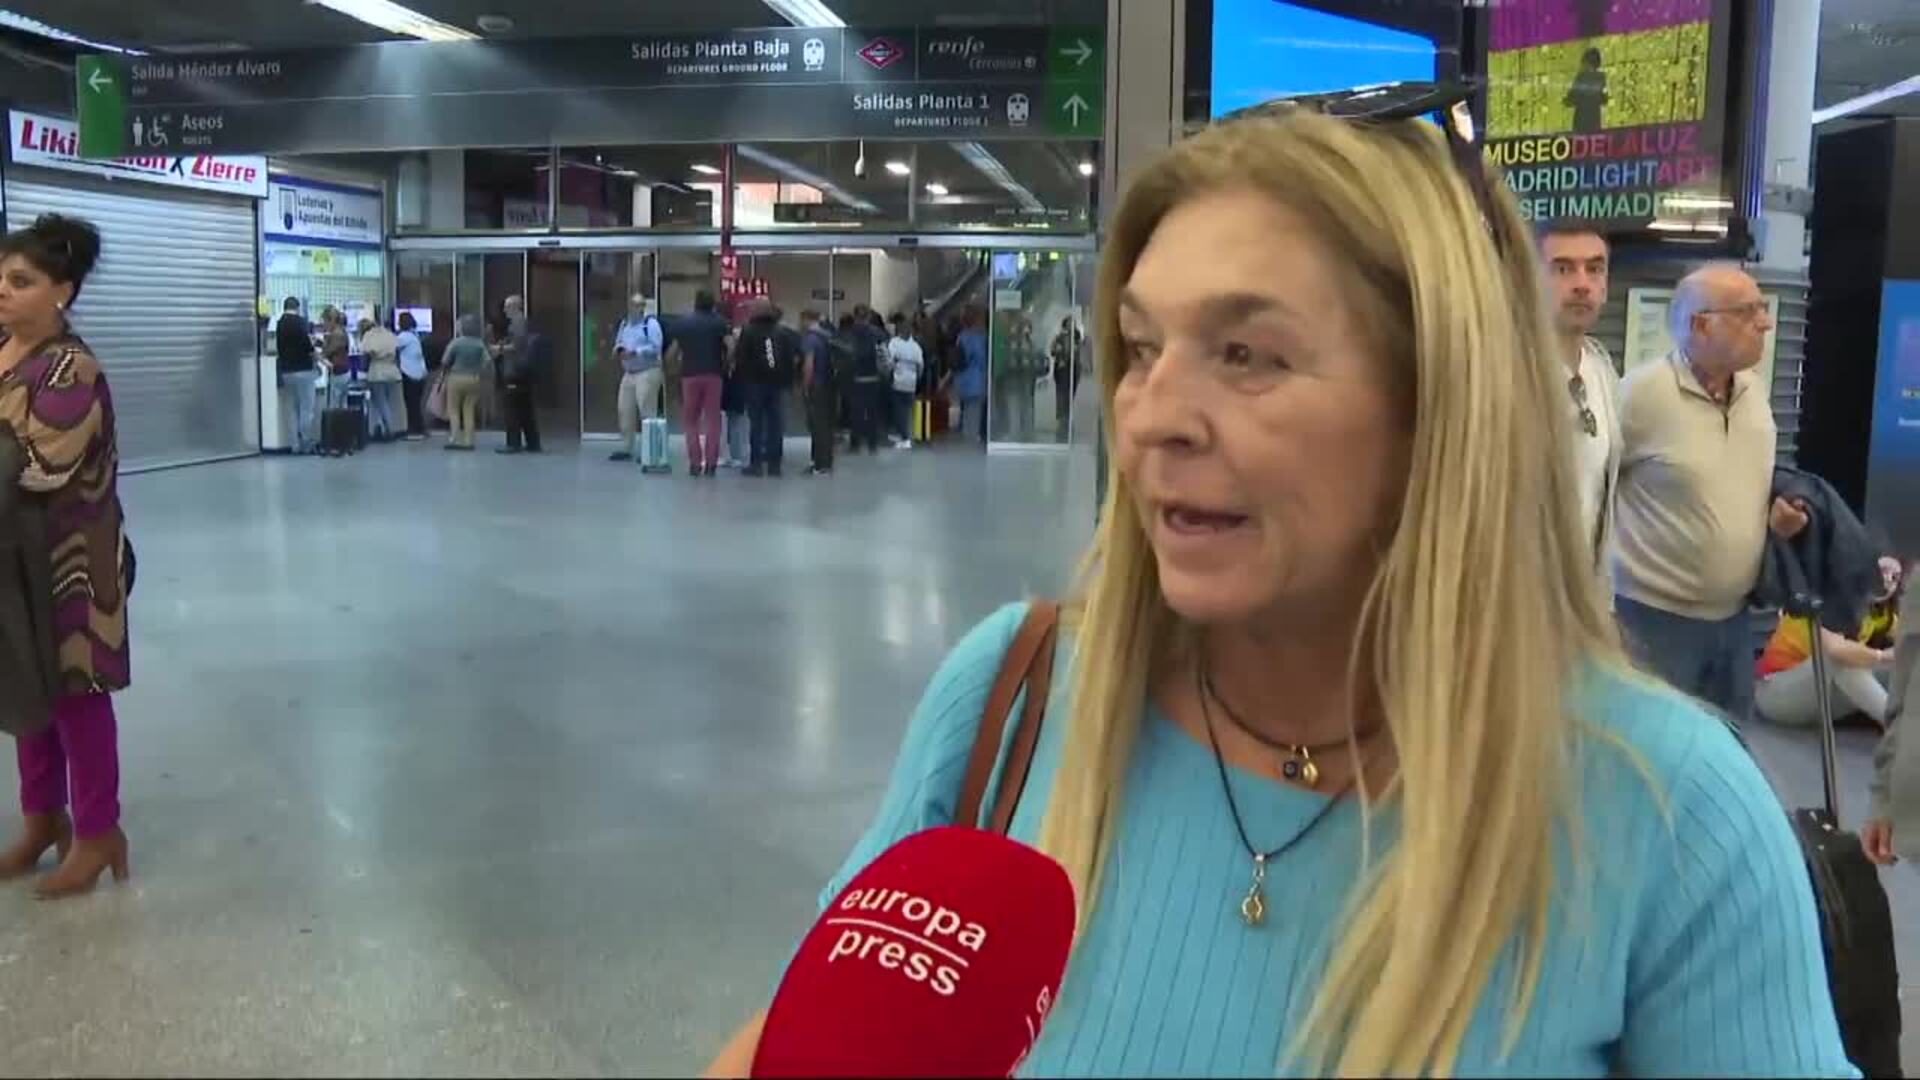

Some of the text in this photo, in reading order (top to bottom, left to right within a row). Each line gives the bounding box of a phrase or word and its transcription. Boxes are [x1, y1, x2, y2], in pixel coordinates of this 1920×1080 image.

[632, 38, 789, 59] Salidas Planta Baja
[928, 36, 985, 58] renfe
[131, 57, 281, 81] Salida Méndez Álvaro
[667, 62, 788, 74] DEPARTURES GROUND FLOOR
[853, 92, 989, 110] Salidas Planta 1
[182, 113, 223, 131] Aseos
[894, 116, 951, 126] DEPARTURES
[192, 153, 256, 184] Zierre
[1505, 156, 1714, 193] ADRIDLIGHTART
[841, 888, 986, 951] europa
[828, 930, 960, 995] press
